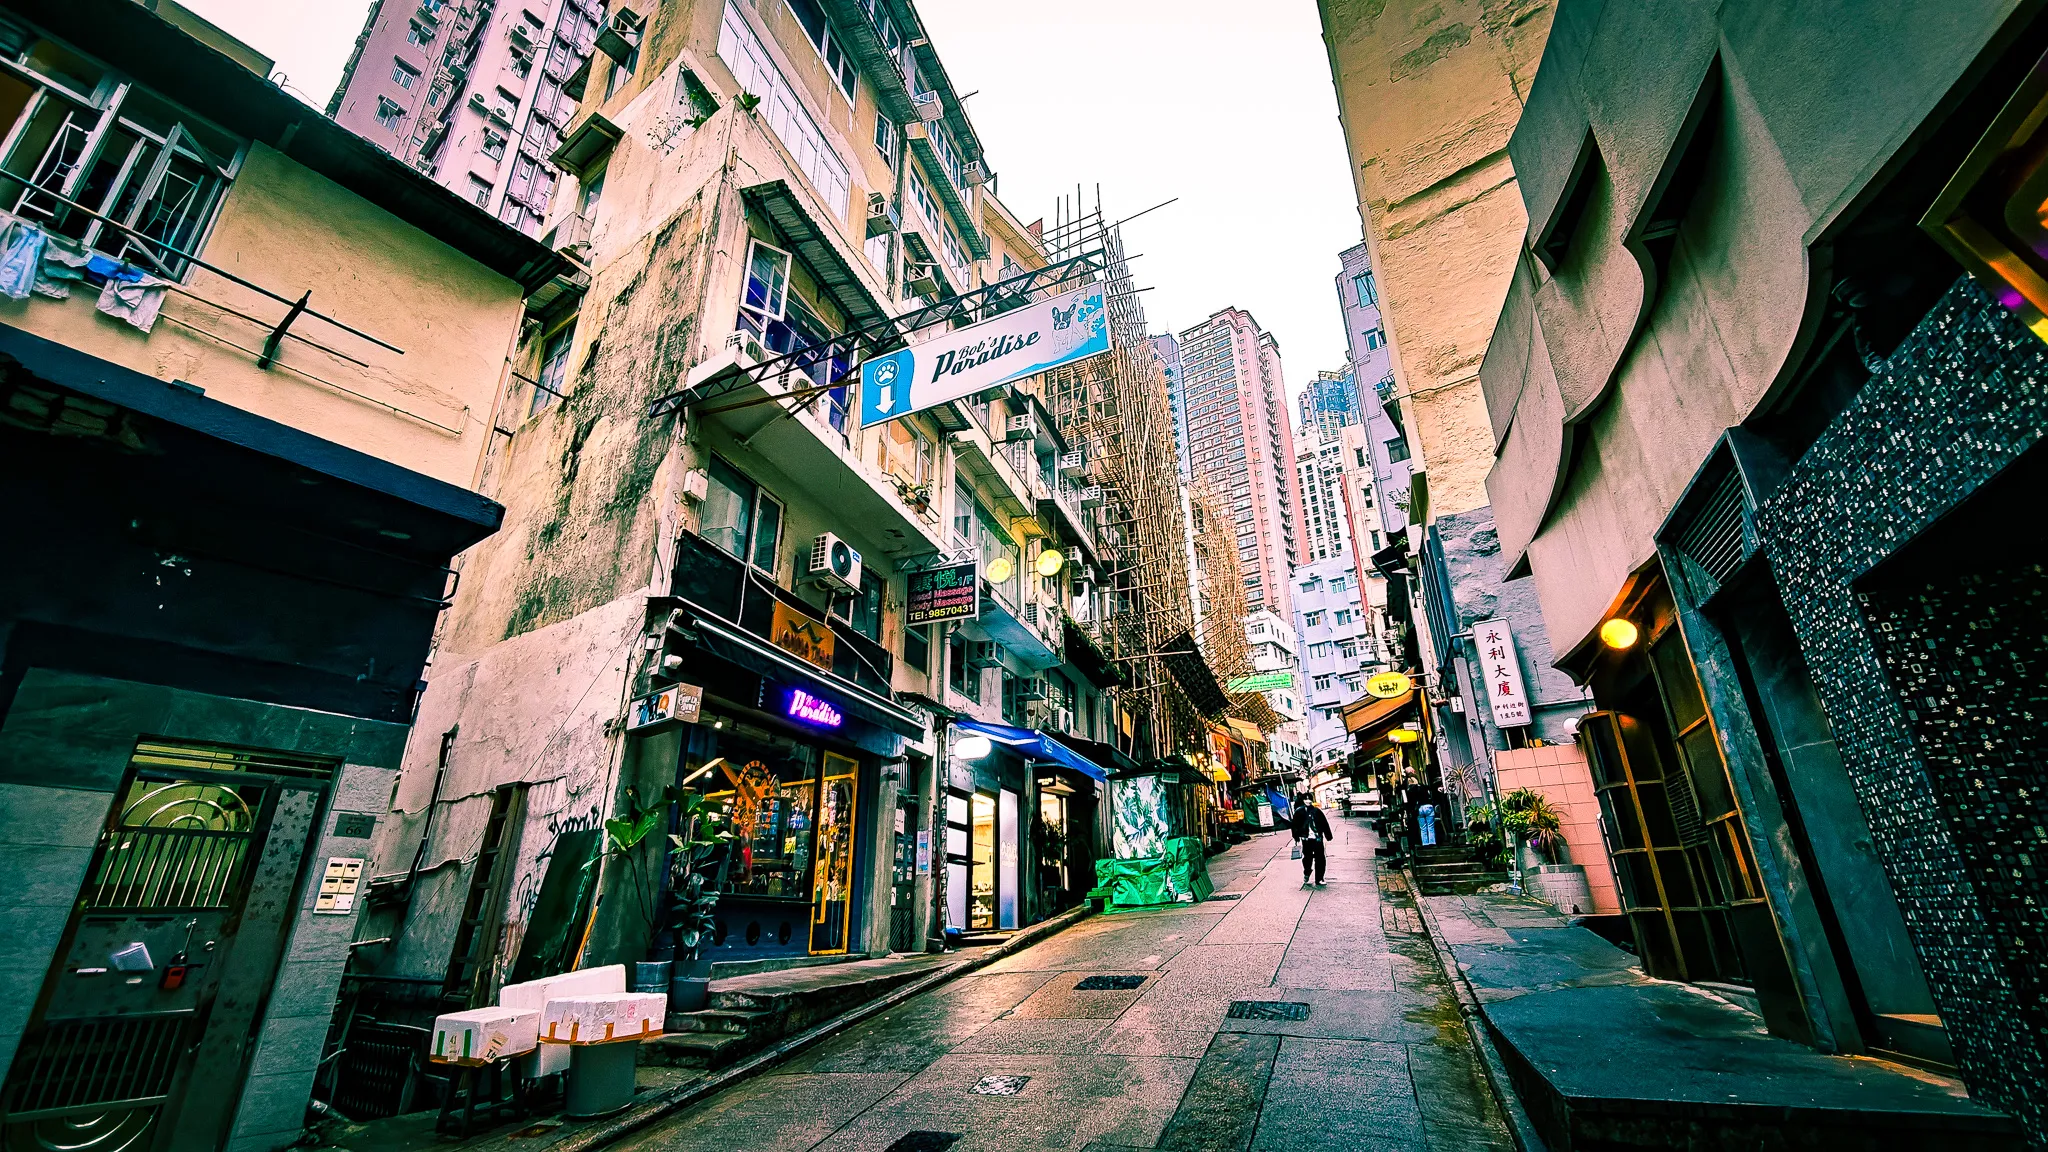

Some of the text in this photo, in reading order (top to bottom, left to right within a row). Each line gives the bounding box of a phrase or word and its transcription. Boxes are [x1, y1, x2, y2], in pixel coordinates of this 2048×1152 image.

[958, 337, 998, 359] Bob's
[931, 330, 1042, 385] Paradise
[958, 574, 974, 586] 1/F
[933, 586, 974, 599] Massage
[933, 595, 974, 608] Massage
[1486, 630, 1515, 697] 永利大廈
[789, 690, 841, 726] Paradise
[345, 826, 361, 836] 66
